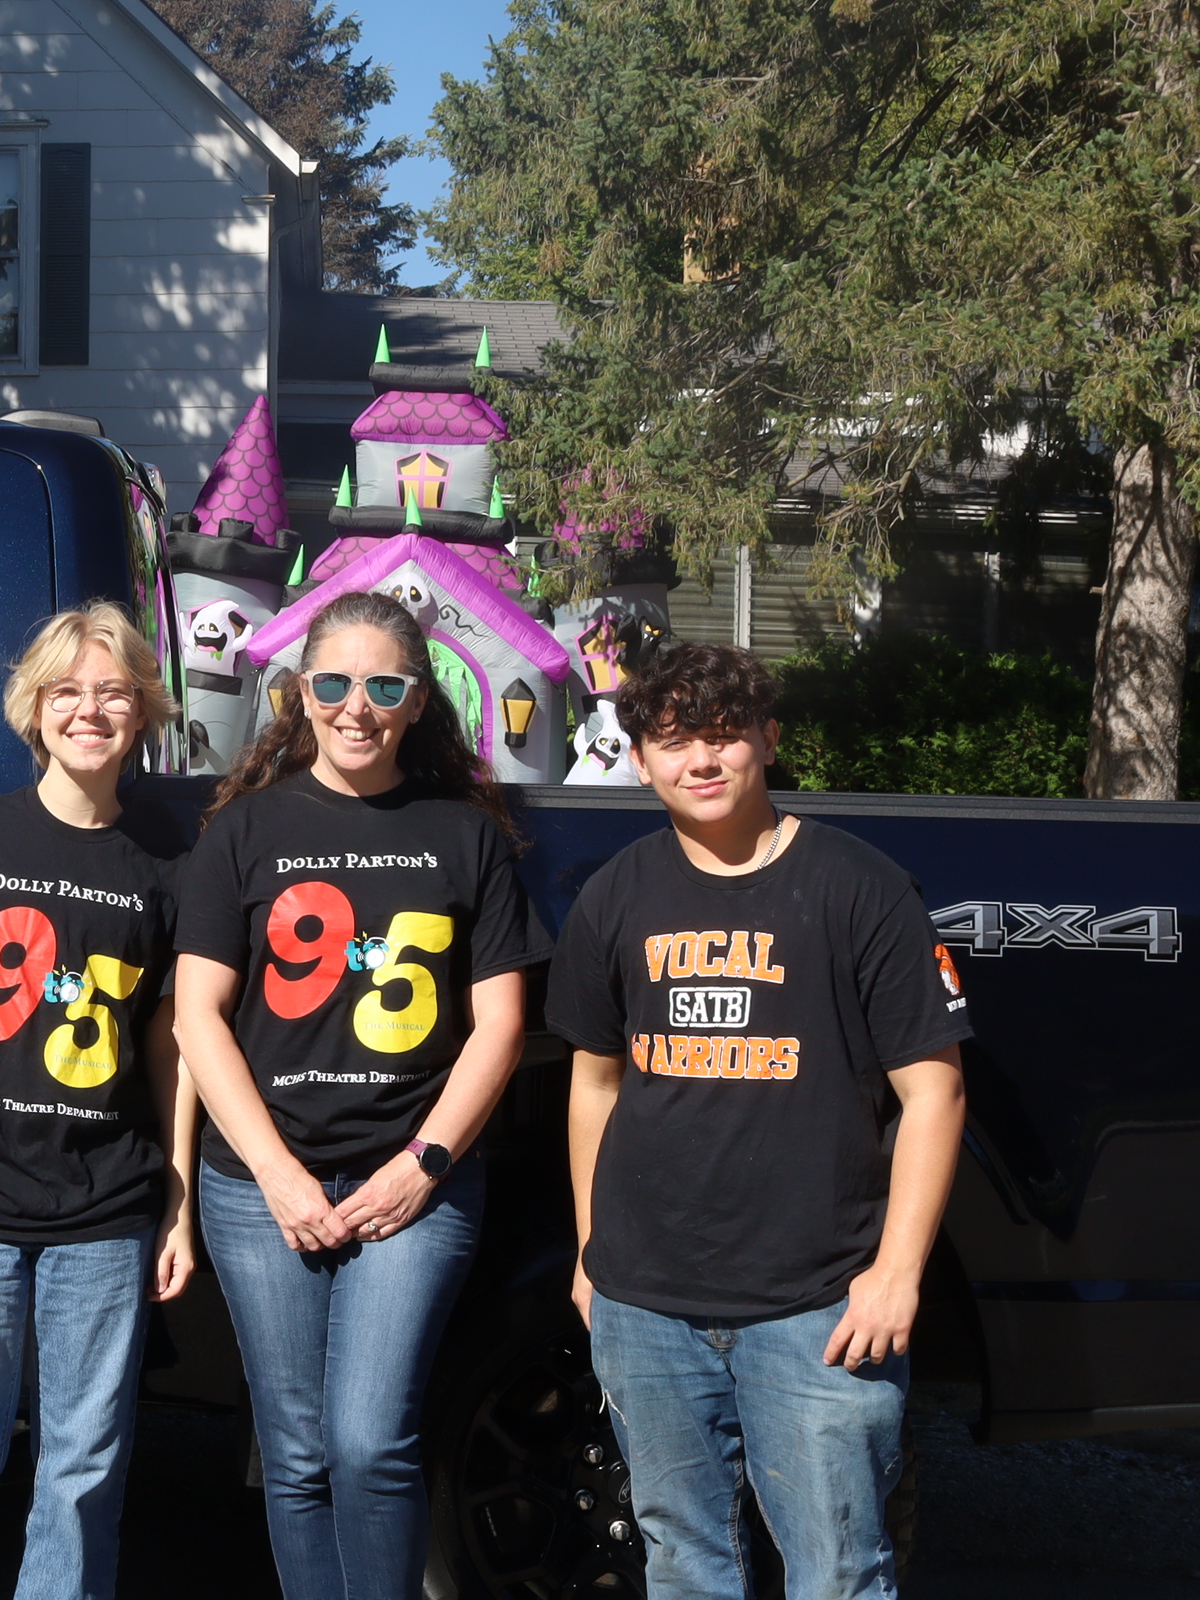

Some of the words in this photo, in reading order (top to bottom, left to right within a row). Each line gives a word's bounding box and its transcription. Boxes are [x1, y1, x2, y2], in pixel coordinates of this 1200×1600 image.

[276, 853, 341, 874] DOLLY
[345, 851, 438, 870] PARTON'S
[57, 878, 144, 912] PARTON'S
[264, 881, 355, 1020] 9
[353, 911, 455, 1053] 5
[644, 930, 785, 985] VOCAL
[44, 954, 144, 1088] 5
[674, 992, 744, 1023] SATB
[386, 1021, 425, 1032] MUSICAL
[73, 1056, 113, 1070] MUSICAL
[631, 1032, 800, 1080] WARRIORS
[307, 1069, 367, 1084] THEATRE
[2, 1098, 55, 1114] THEATRE
